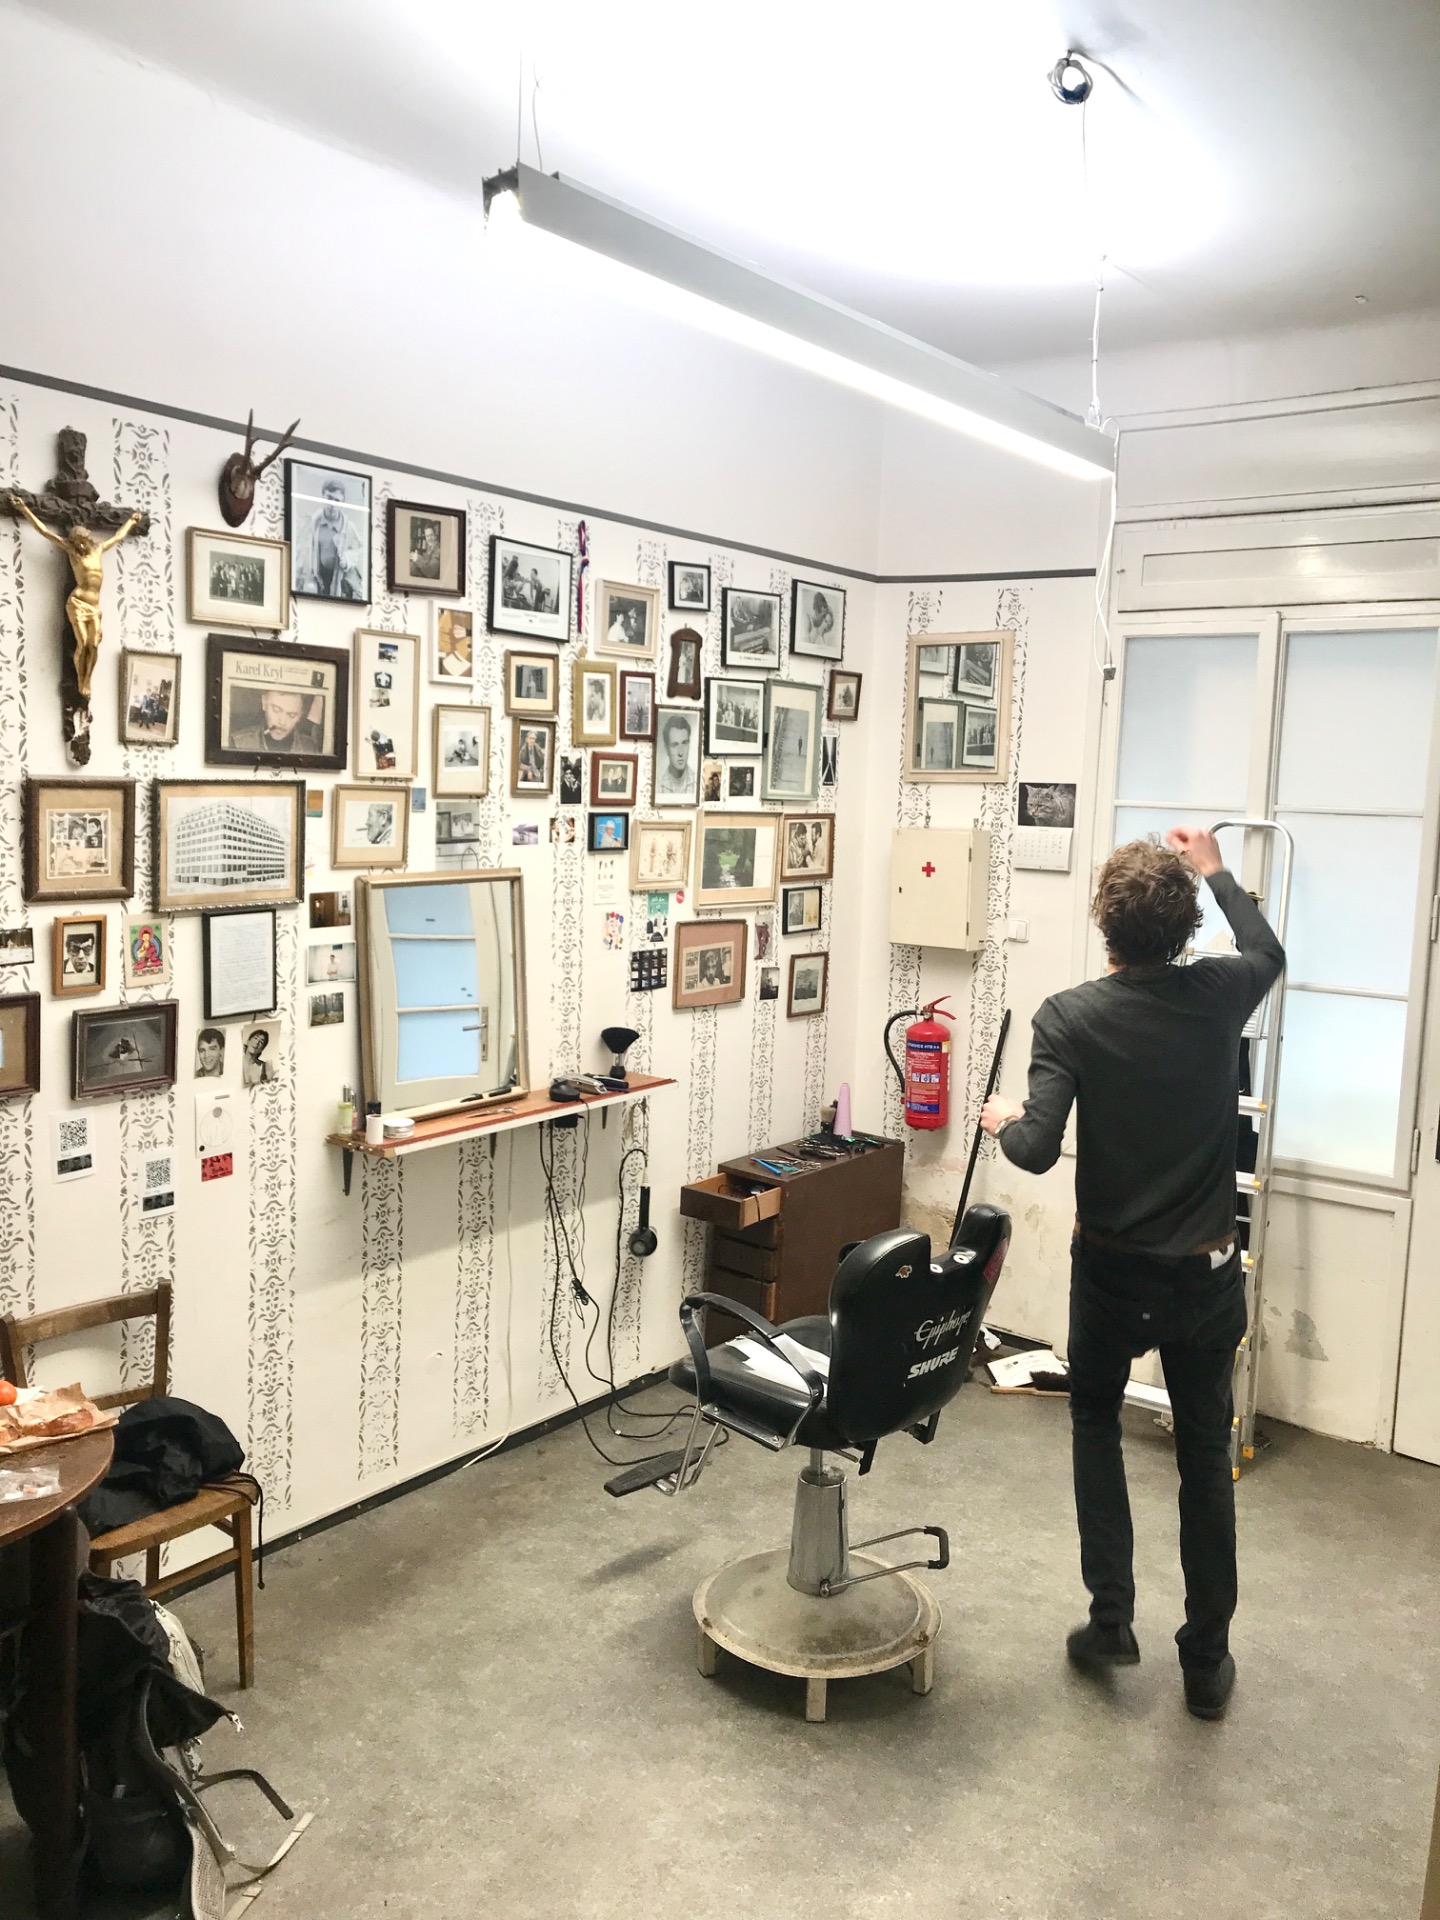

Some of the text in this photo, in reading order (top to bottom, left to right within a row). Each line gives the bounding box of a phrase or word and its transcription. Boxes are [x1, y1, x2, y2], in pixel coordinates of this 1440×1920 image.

[235, 661, 261, 675] Karel
[263, 664, 283, 681] Kryl
[914, 1309, 972, 1350] Epiphone
[907, 1346, 959, 1379] SHURE
